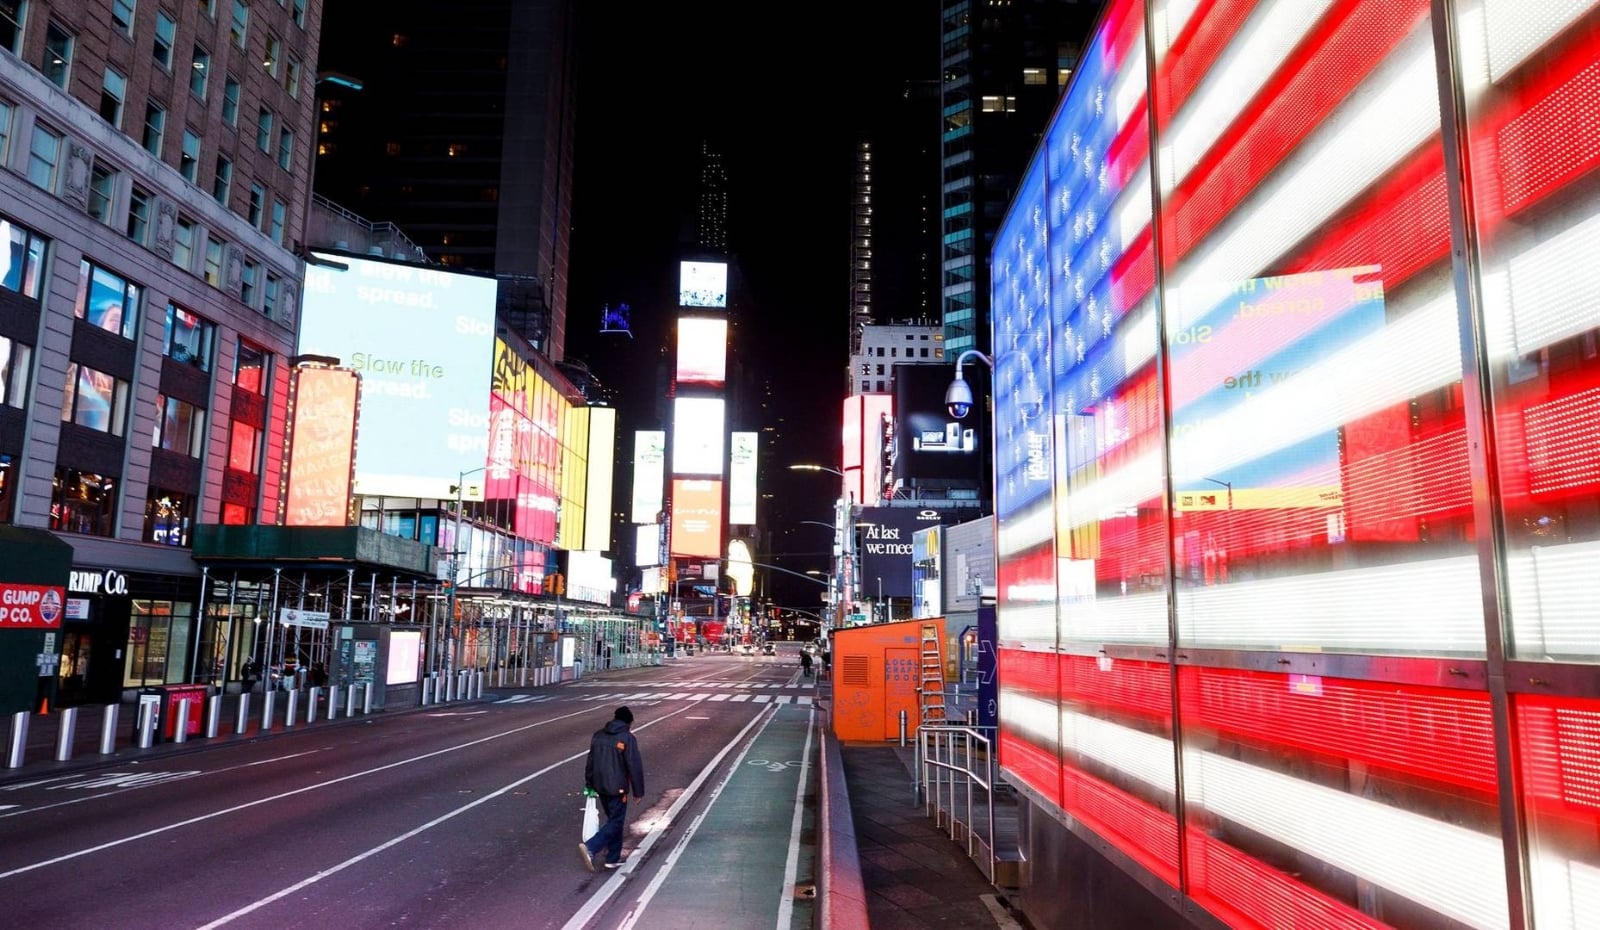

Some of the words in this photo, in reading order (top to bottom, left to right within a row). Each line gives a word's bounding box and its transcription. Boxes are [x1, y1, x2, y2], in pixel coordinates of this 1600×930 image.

[356, 285, 440, 310] spread.
[351, 352, 405, 375] Slow
[410, 360, 445, 378] the
[865, 525, 880, 539] At
[881, 525, 900, 539] last
[866, 543, 885, 554] we
[3, 589, 41, 605] GUMP
[10, 607, 32, 622] CO.
